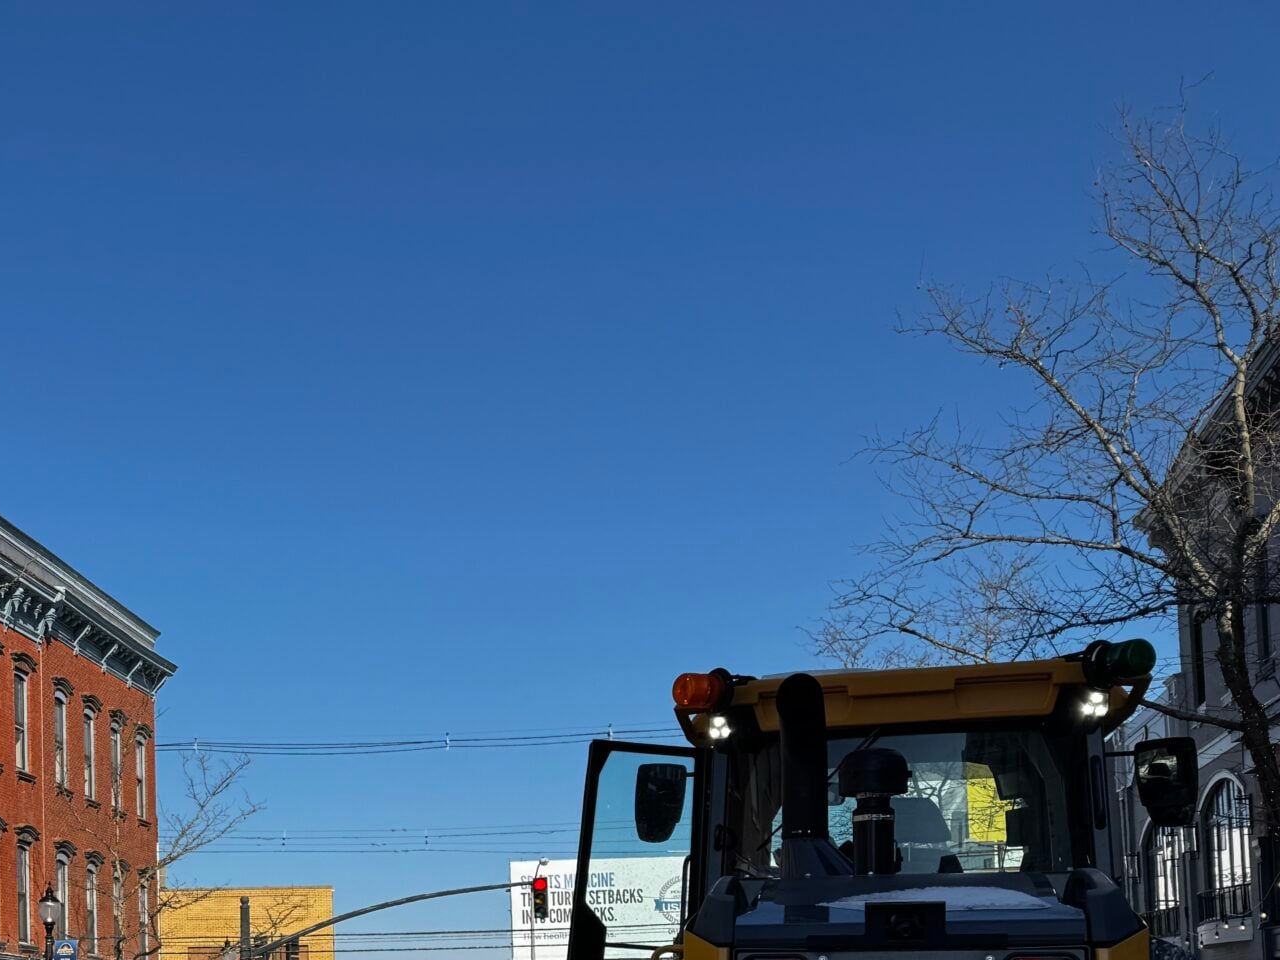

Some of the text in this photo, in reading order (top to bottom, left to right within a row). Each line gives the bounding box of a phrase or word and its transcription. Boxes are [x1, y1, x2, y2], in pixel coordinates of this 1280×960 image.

[521, 873, 561, 890] SPTS
[552, 891, 574, 907] TUR
[589, 888, 644, 905] SETBACKS
[549, 907, 618, 924] COMCKS.
